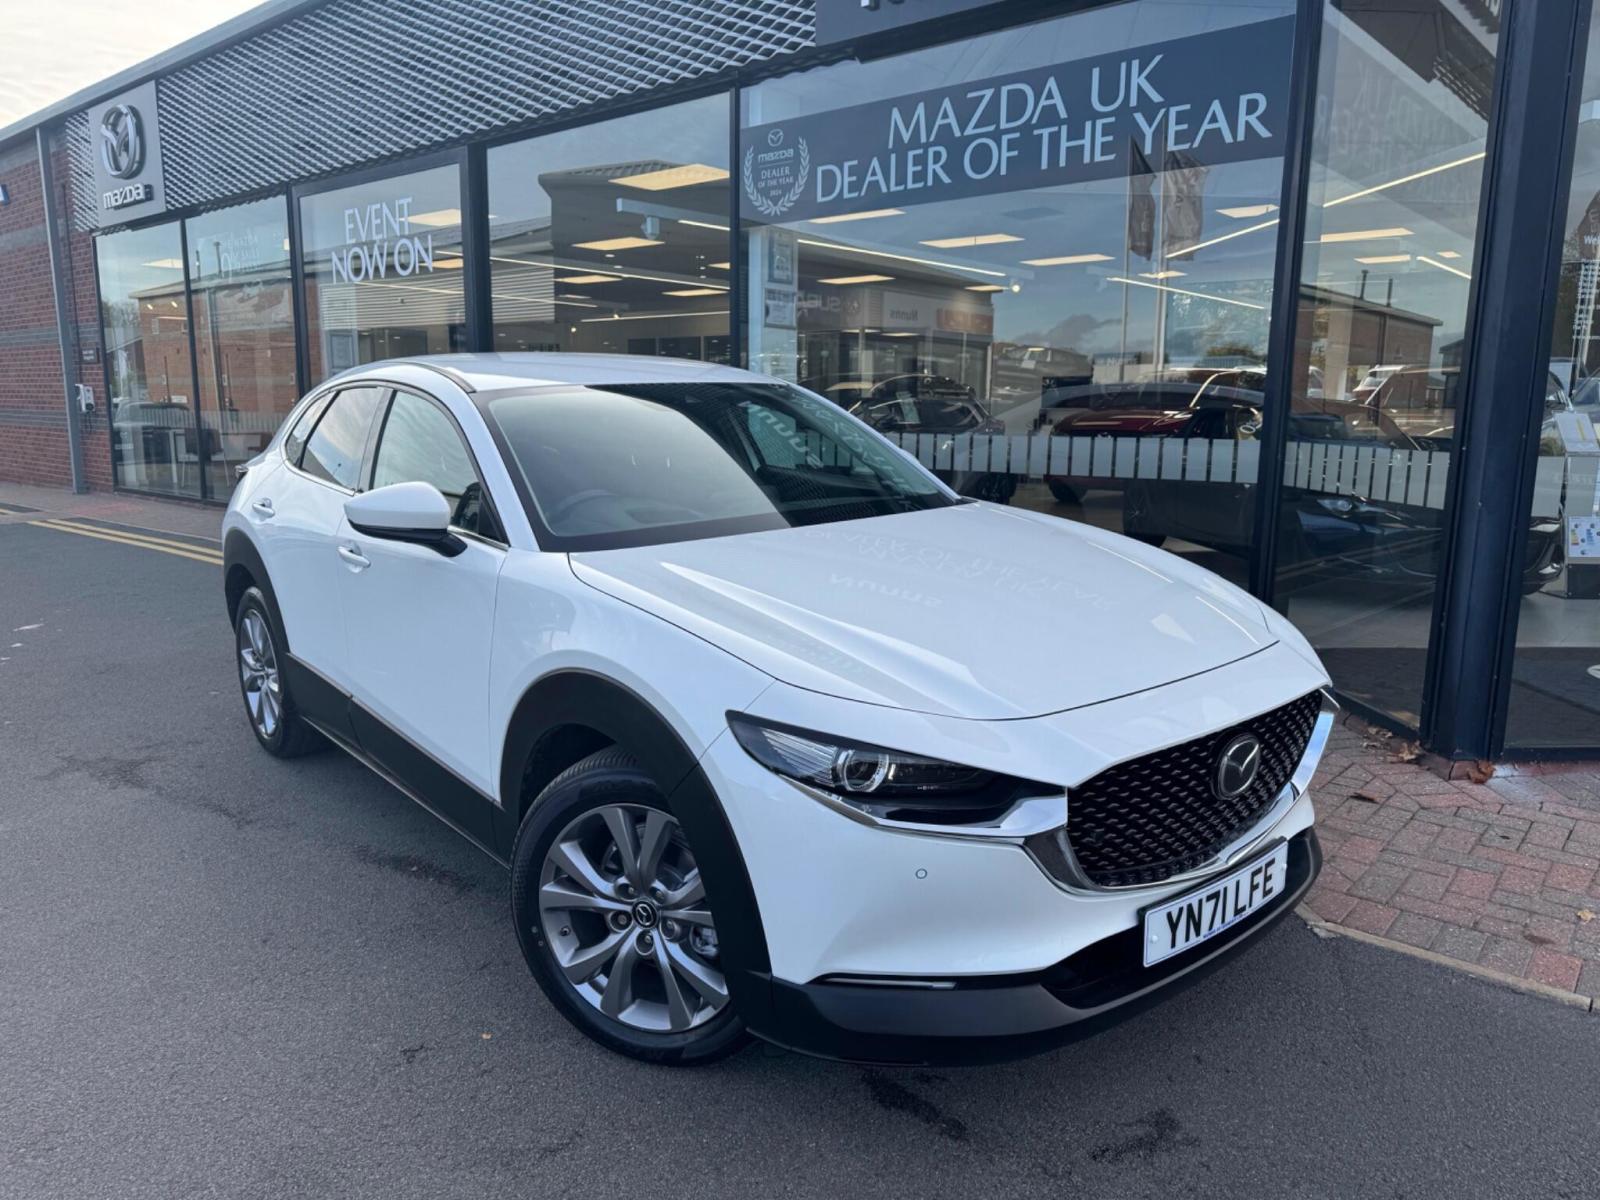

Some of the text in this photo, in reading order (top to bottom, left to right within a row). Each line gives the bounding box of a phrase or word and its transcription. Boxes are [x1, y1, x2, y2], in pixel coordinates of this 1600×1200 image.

[888, 54, 1167, 150] MAZDA UK
[761, 166, 790, 180] DEALER
[816, 145, 952, 203] DEALER
[963, 134, 1021, 180] OF
[1033, 116, 1117, 171] THE
[1132, 92, 1273, 155] YEAR
[344, 197, 412, 245] EVENT
[331, 234, 434, 285] NOW ON
[1166, 886, 1228, 949] YN71
[1233, 857, 1275, 917] LFE
